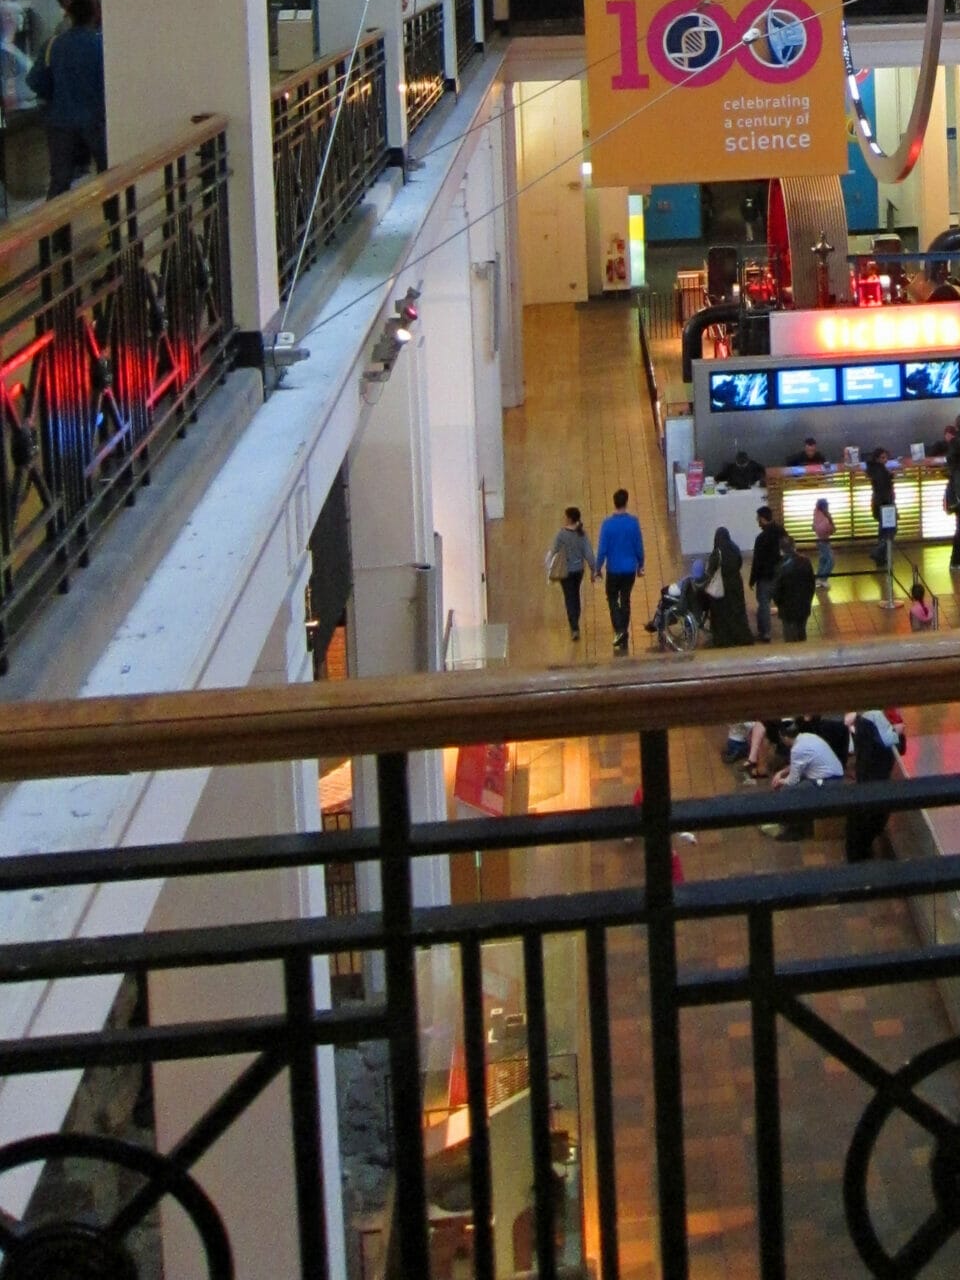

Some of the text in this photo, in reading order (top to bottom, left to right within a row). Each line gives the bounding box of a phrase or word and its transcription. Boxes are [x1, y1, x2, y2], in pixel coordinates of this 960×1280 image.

[723, 95, 810, 111] celebrating
[724, 112, 809, 128] a century of
[725, 131, 811, 152] science
